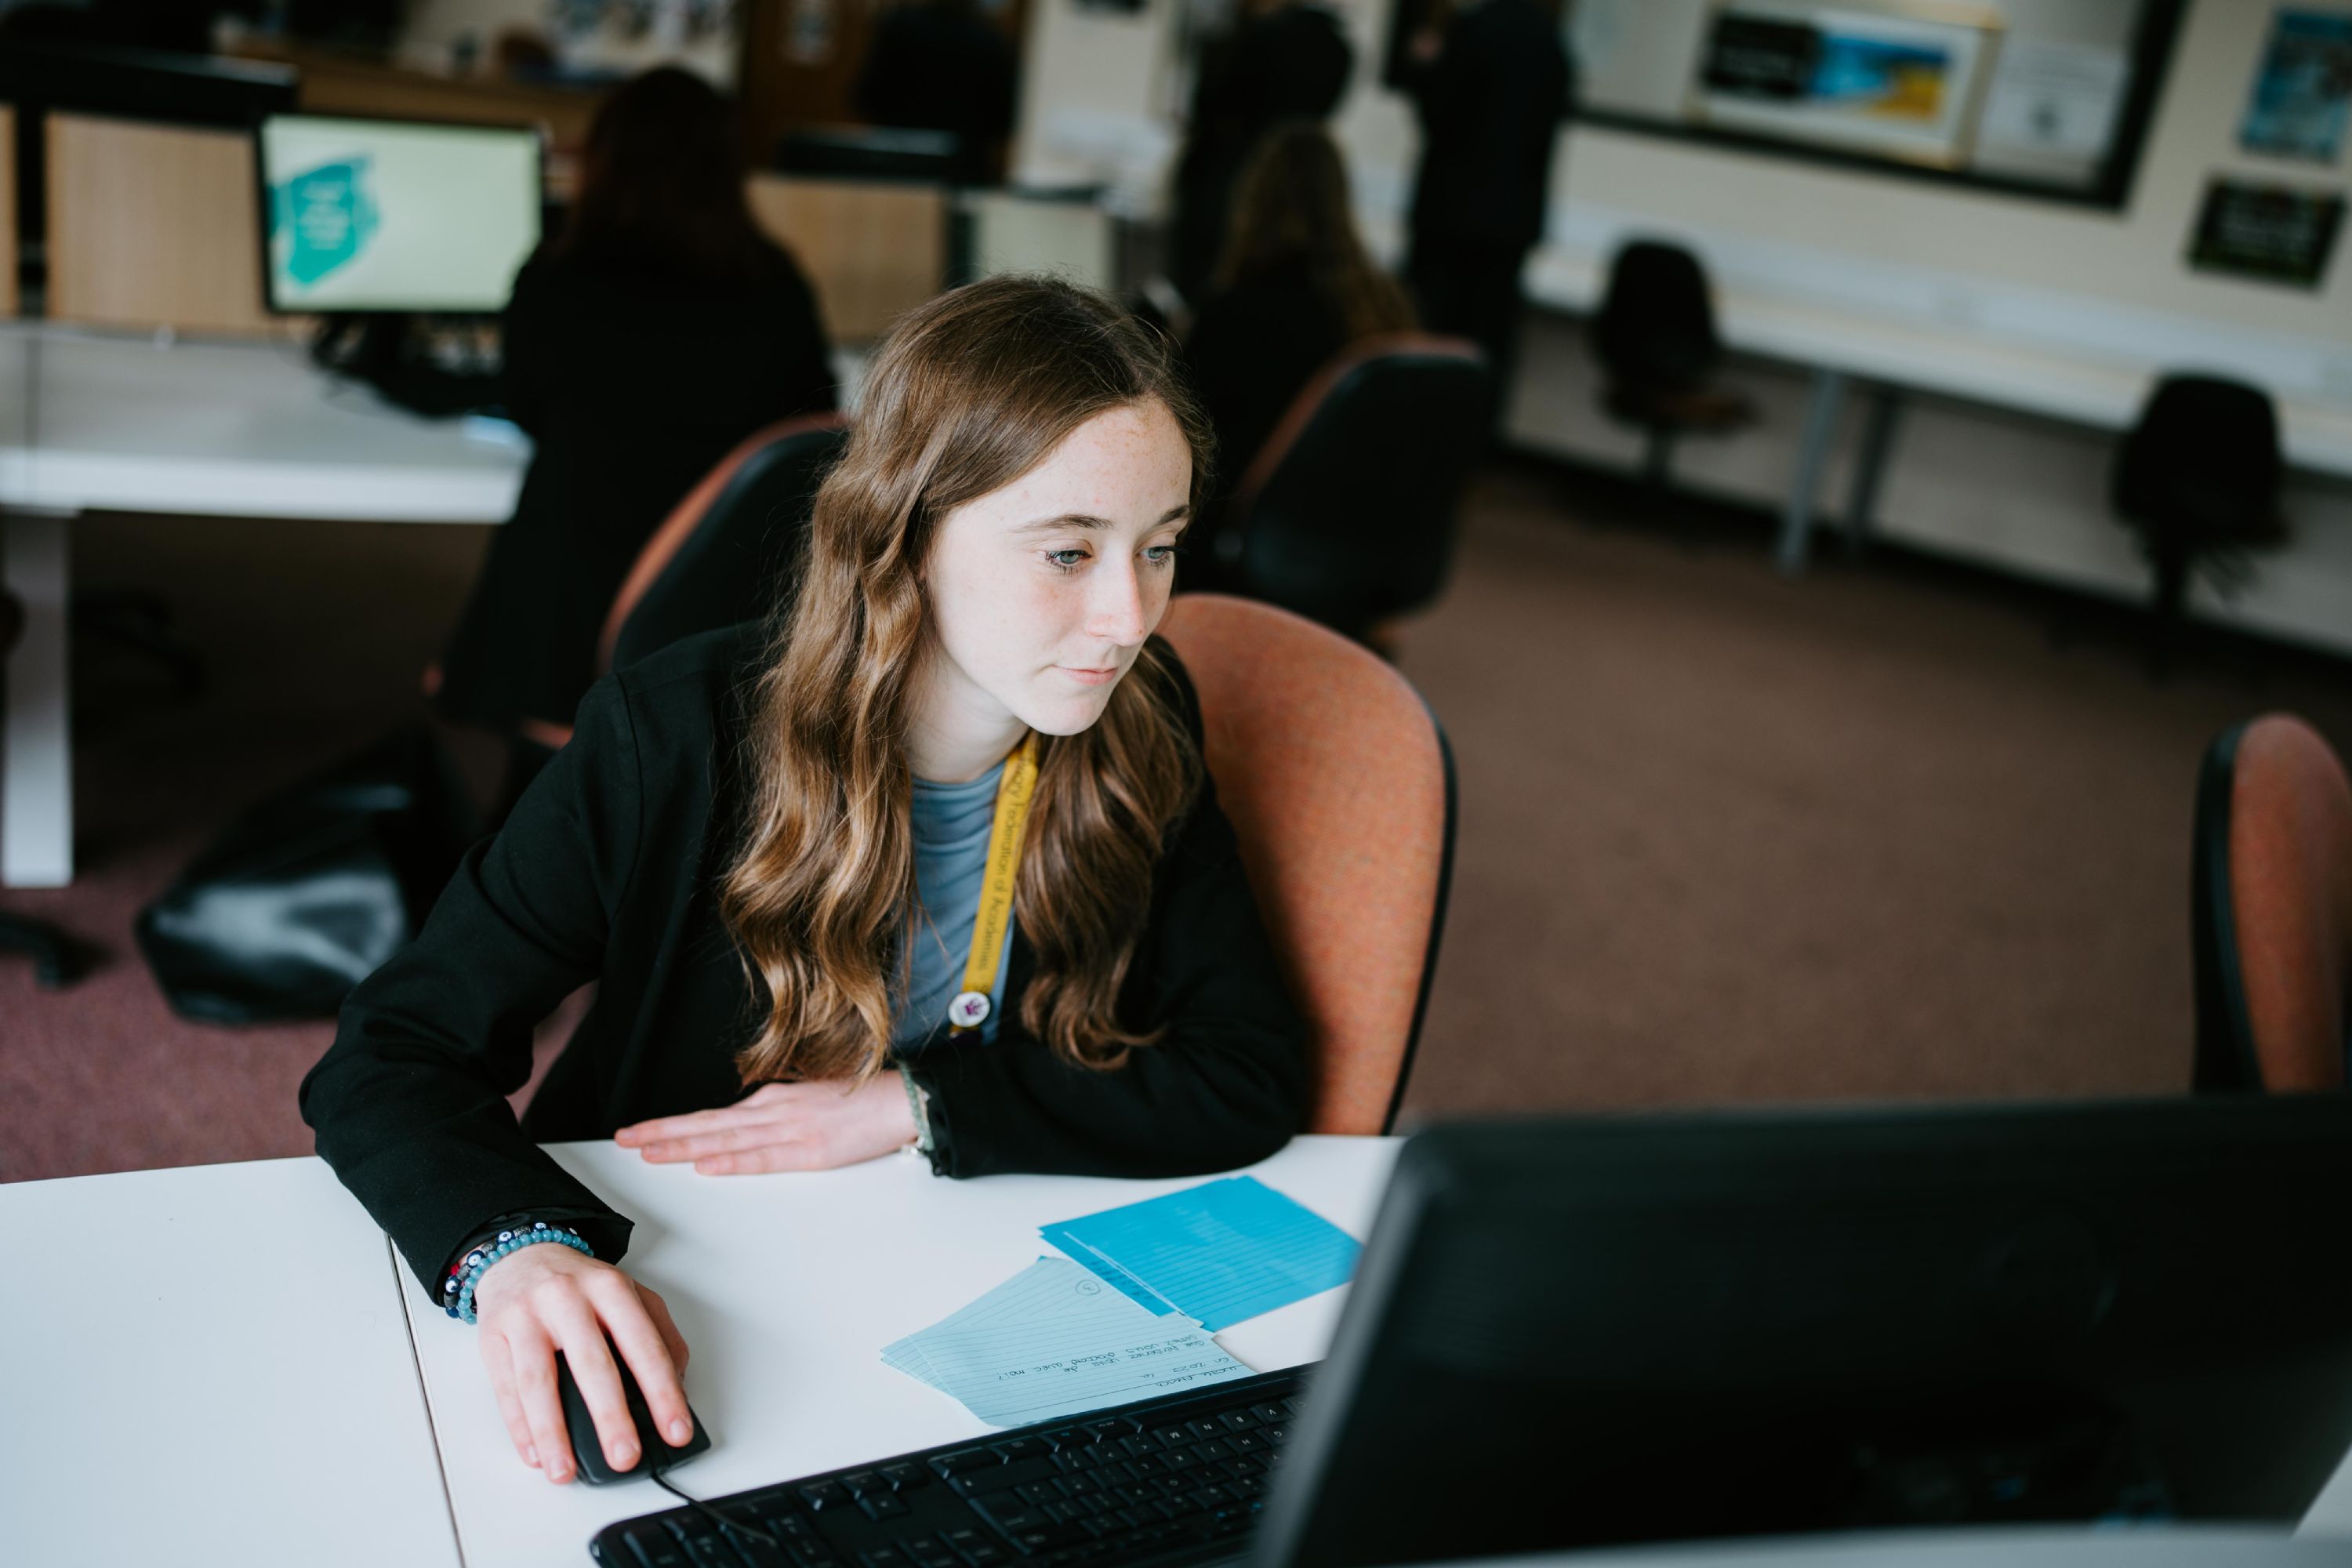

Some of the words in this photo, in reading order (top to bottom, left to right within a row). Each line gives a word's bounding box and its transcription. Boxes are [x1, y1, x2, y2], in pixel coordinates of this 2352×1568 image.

[996, 802, 1025, 876] Federation
[993, 880, 1009, 893] of
[1033, 1362, 1063, 1373] avec
[1172, 1362, 1207, 1374] 2023
